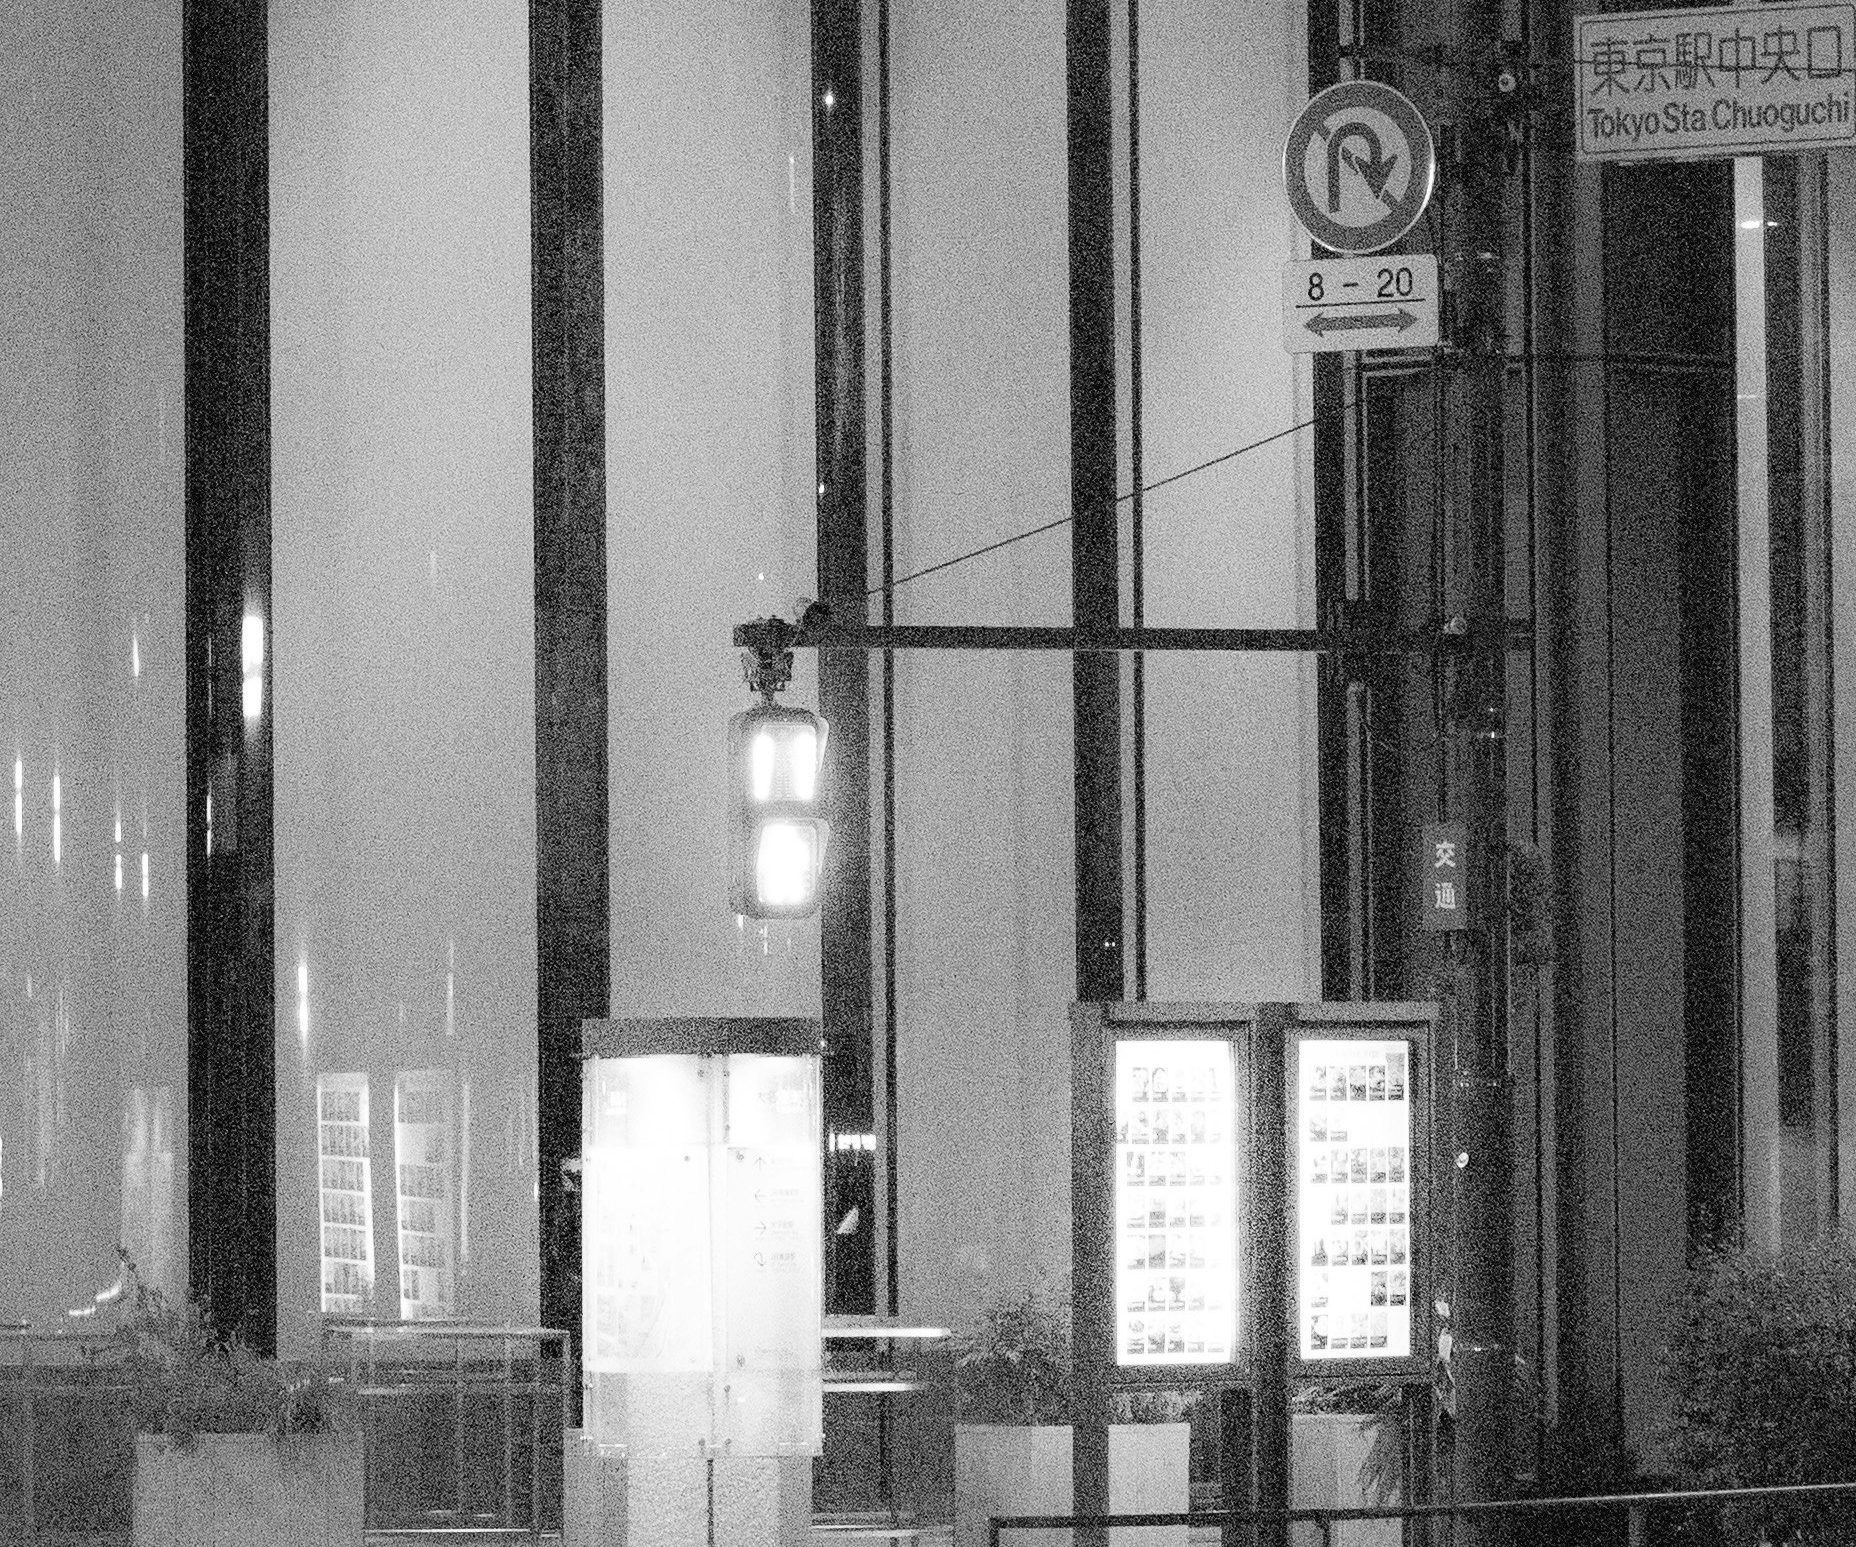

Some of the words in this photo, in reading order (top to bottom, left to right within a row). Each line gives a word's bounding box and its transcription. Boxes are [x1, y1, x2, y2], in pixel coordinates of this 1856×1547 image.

[1590, 25, 1842, 97] 東京駅中央口
[1587, 105, 1660, 141] Tokyo
[1712, 92, 1849, 133] Chuoguchi
[1308, 272, 1325, 301] 8
[1377, 267, 1413, 298] 20
